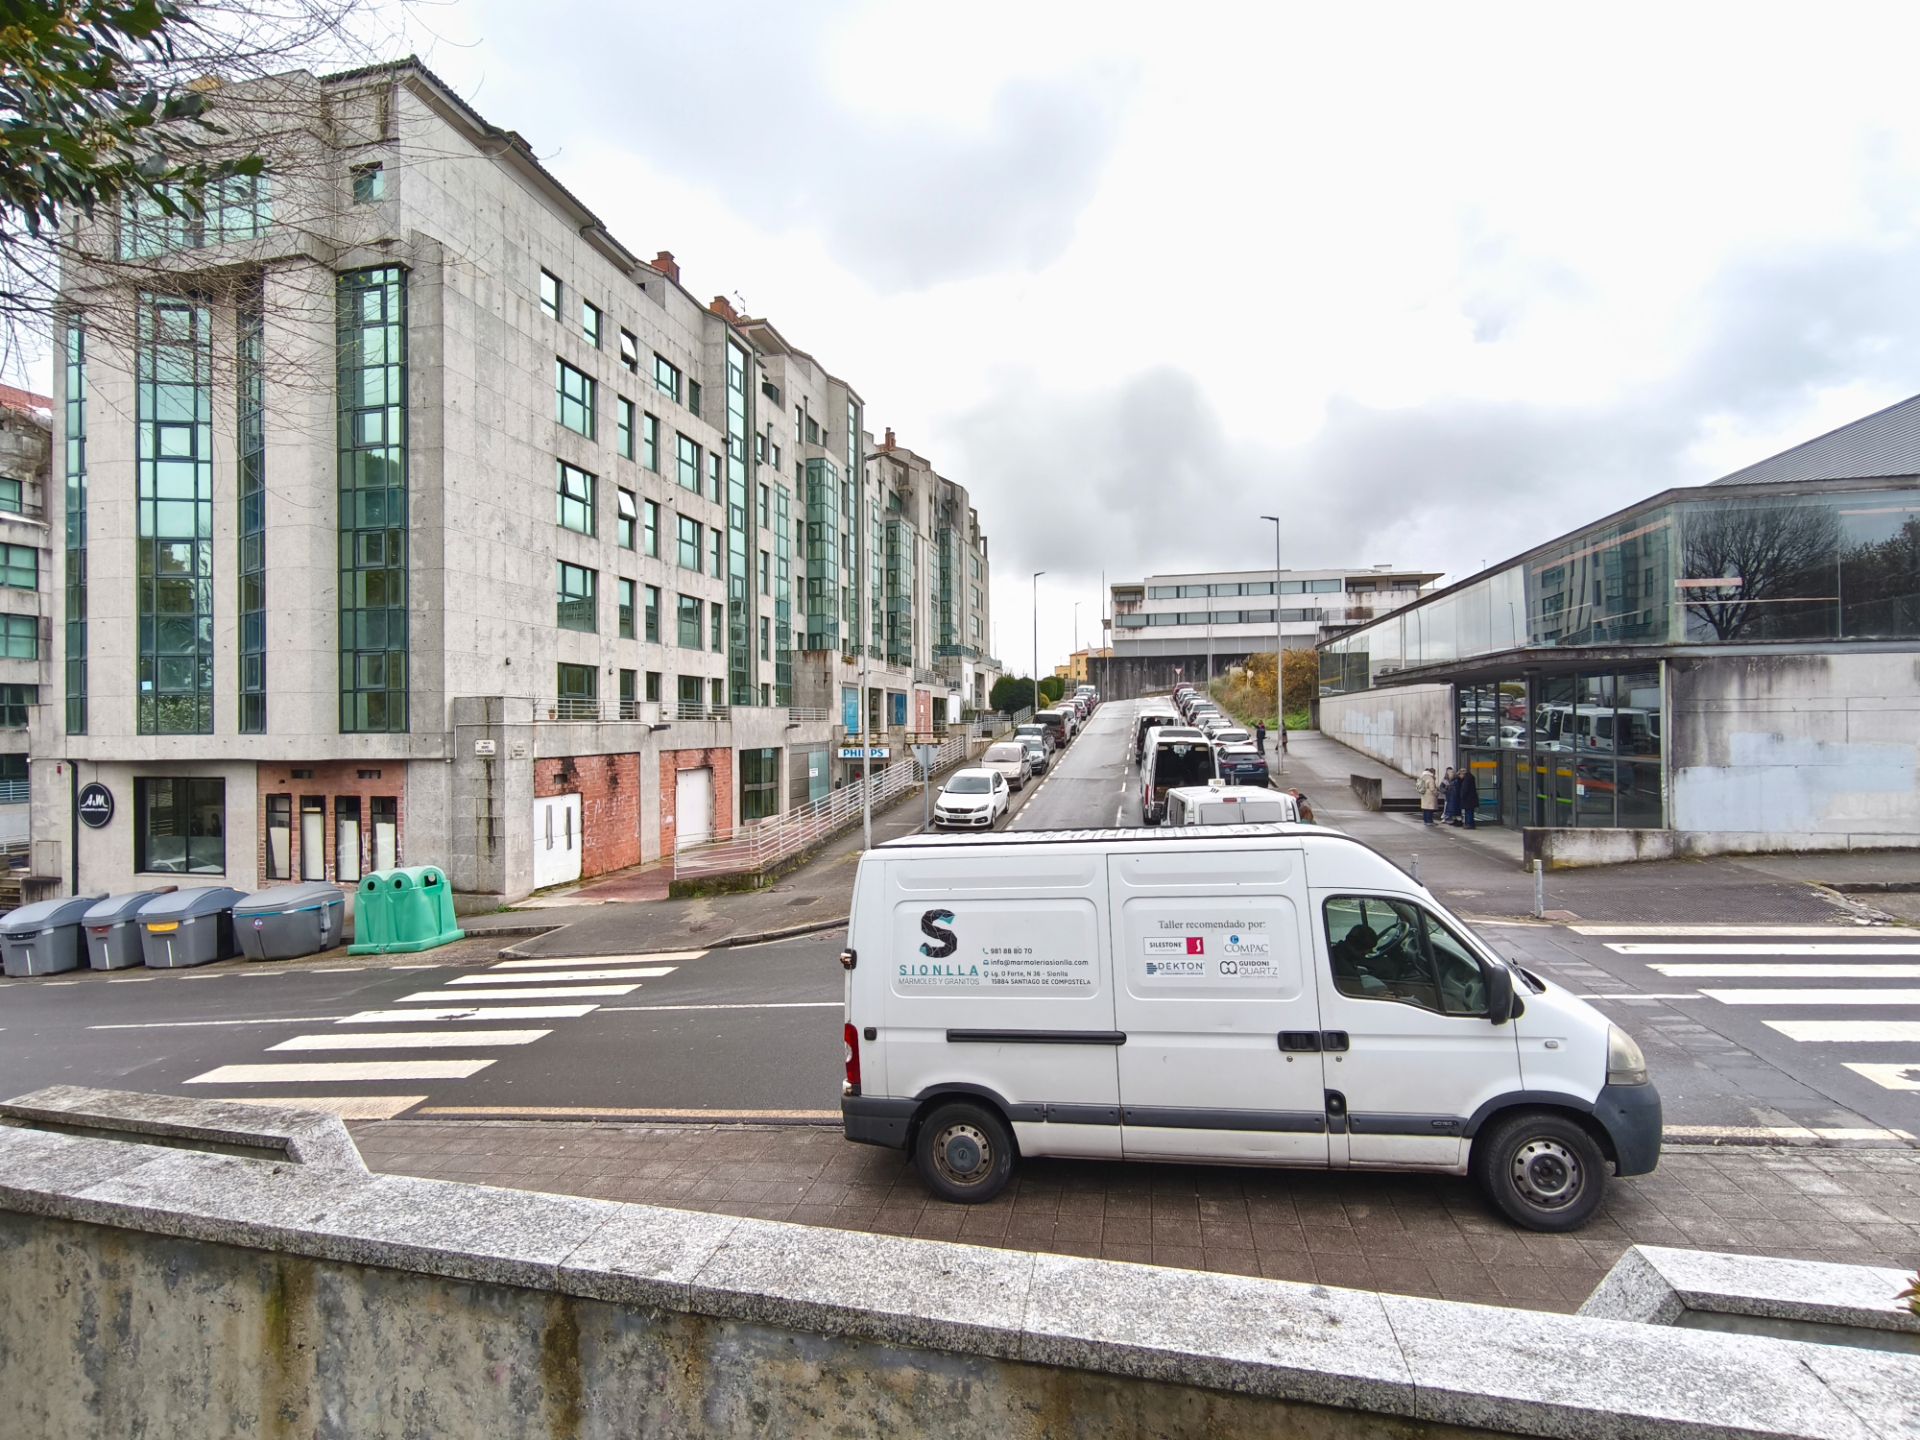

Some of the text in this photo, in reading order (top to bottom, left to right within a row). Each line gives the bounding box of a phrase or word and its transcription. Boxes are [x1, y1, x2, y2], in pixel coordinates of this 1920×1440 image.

[843, 748, 883, 757] PHIPS
[1158, 920, 1266, 931] Taller recomendado por:
[1224, 944, 1268, 953] COMPAC
[899, 964, 979, 976] SIONLLA
[1158, 962, 1203, 970] DEKTON
[1239, 967, 1278, 976] QUARTZ
[944, 977, 980, 985] GRANITOS
